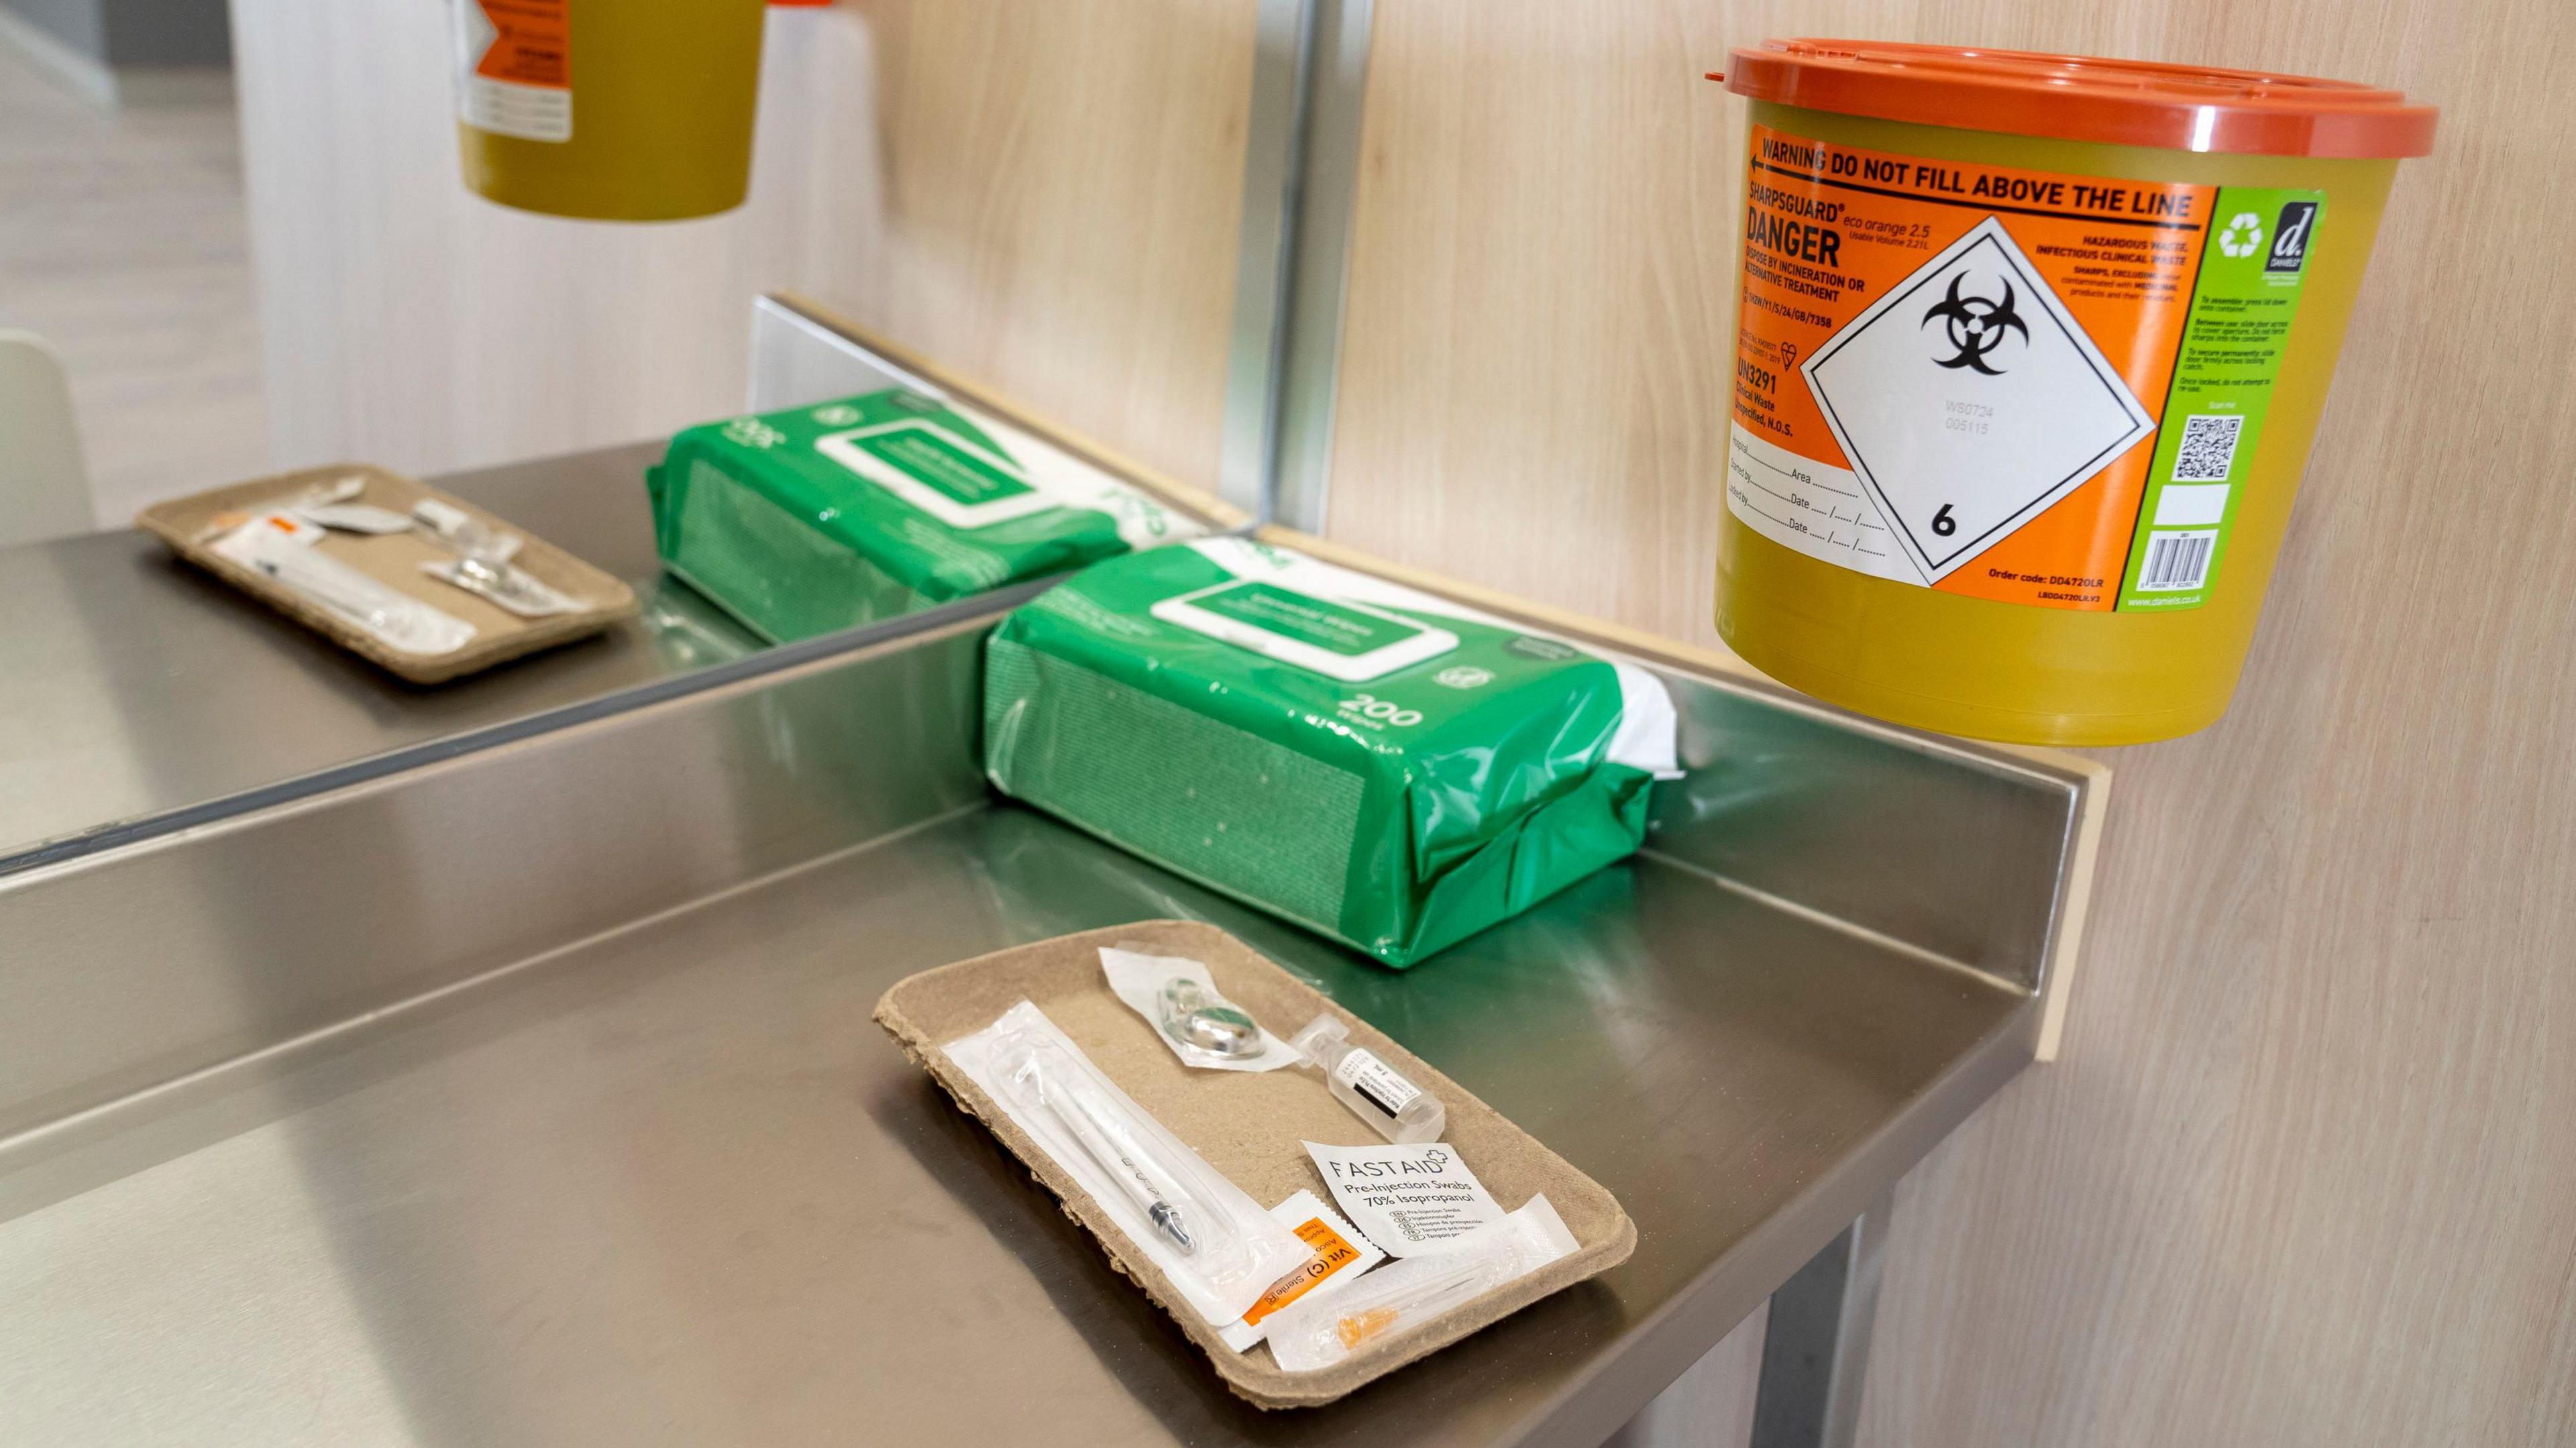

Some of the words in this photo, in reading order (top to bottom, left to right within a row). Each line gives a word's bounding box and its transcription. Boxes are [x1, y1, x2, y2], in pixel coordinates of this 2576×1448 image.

[1762, 137, 1827, 171] WARNING
[1831, 153, 1858, 177] DO
[1863, 158, 1910, 185] NOT
[1915, 166, 1966, 194] FILL
[1972, 174, 2065, 206] ABOVE
[2073, 185, 2127, 213] THE
[2131, 192, 2193, 217] LINE
[1843, 215, 1862, 229] eco
[1864, 219, 1907, 239] orange
[1909, 224, 1931, 239] 2.5
[1747, 205, 1841, 268] DANGER
[1849, 231, 1874, 243] Usable
[1876, 233, 1905, 248] Volume
[2082, 235, 2147, 250] HAZARDOUS
[2035, 245, 2098, 260] INFECTIOUS
[2100, 252, 2147, 265] CLINICAL
[1746, 245, 1768, 265] DISPOSE
[1768, 256, 1778, 269] BY
[1779, 260, 1845, 288] INCINERATION
[1847, 278, 1865, 292] OR
[1745, 261, 1782, 287] ALTERNATIVE
[1783, 276, 1840, 302] TREATMENT
[2116, 280, 2133, 290] with
[2108, 290, 2122, 300] and
[1738, 356, 1776, 395] UN3291
[1736, 380, 1752, 402] Clinical
[1754, 392, 1776, 412] Waste
[1735, 397, 1766, 428] Unspecified,
[1768, 416, 1794, 437] N.O.S.
[1945, 417, 1989, 435] 005115
[1791, 468, 1811, 484] Area
[1790, 493, 1810, 510] Date
[1789, 518, 1809, 534] Date
[1931, 503, 1956, 537] 6
[1989, 568, 2018, 581] Order
[2021, 574, 2047, 584] code:
[1338, 693, 1423, 727] 200
[1344, 1180, 1430, 1194] Pre-Injection
[1430, 1180, 1472, 1191] Swabs
[1362, 1196, 1396, 1208] 70%
[1396, 1193, 1475, 1206] Isopropanol
[1315, 1238, 1337, 1253] Asco
[1328, 1248, 1352, 1262] Vit
[1307, 1259, 1331, 1278] (C)
[1276, 1275, 1305, 1296] Sterile
